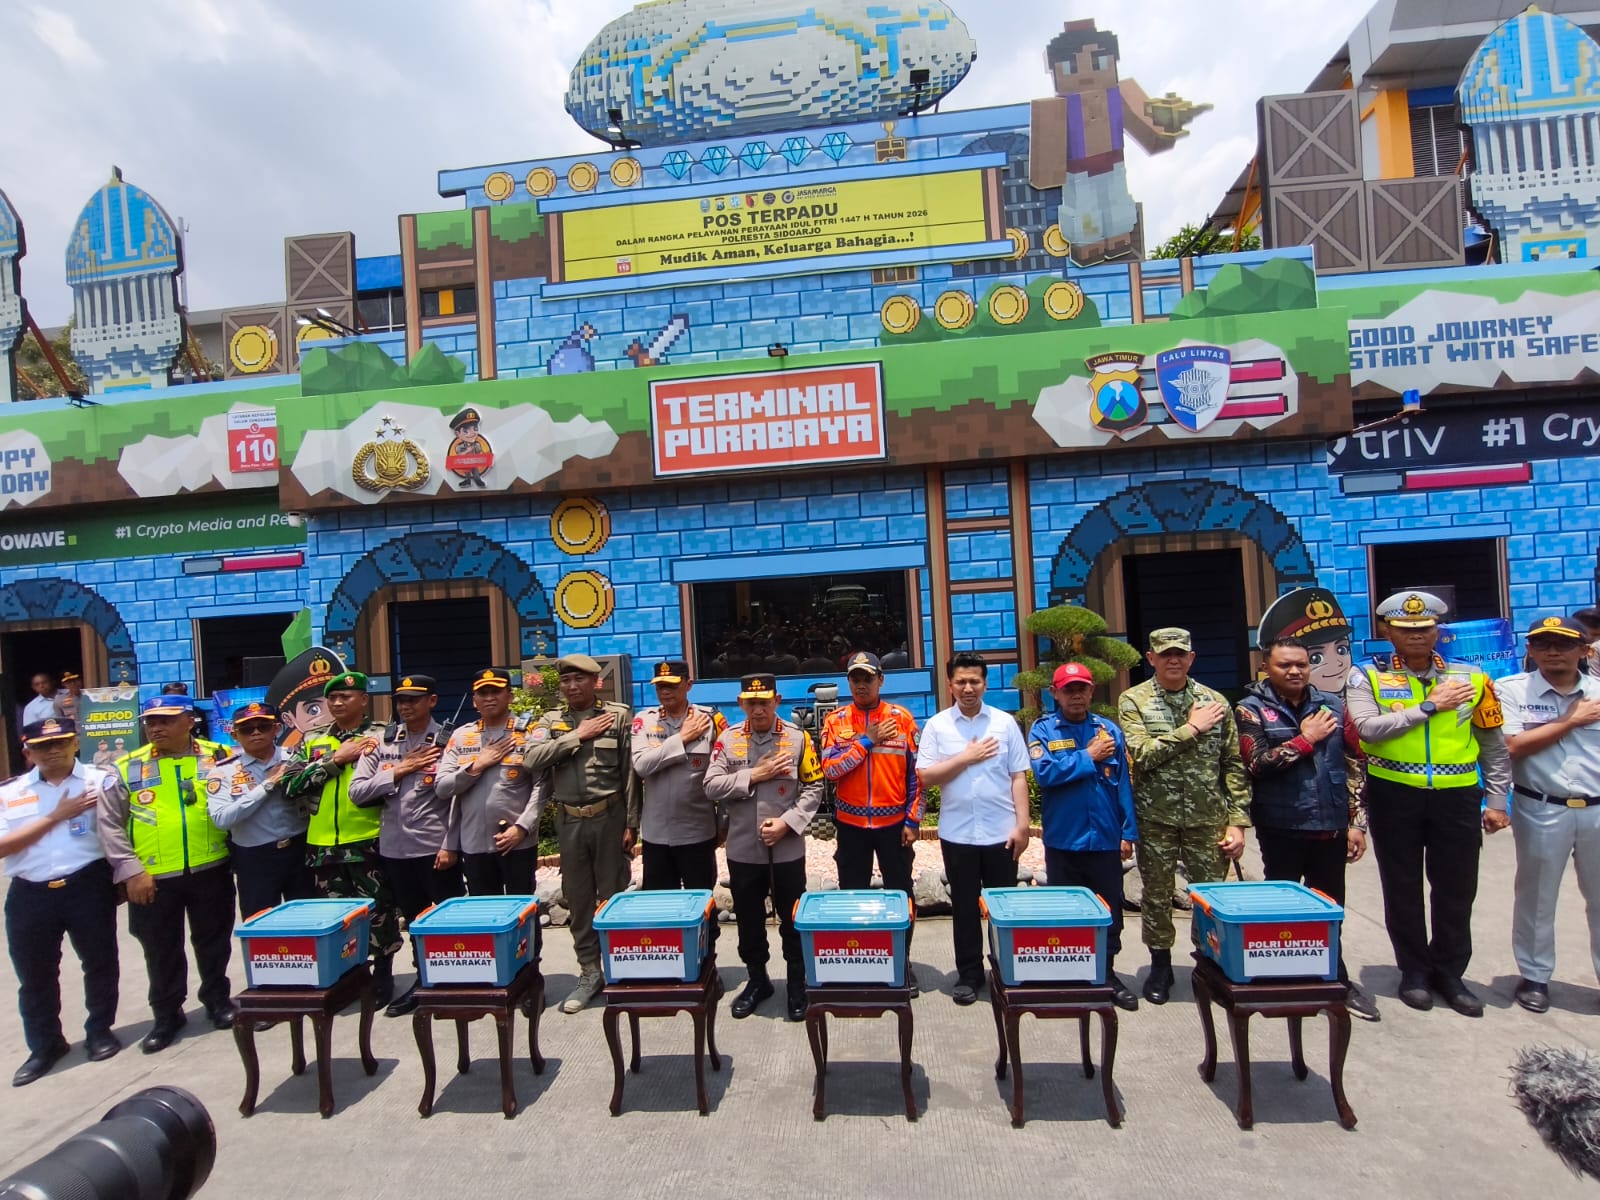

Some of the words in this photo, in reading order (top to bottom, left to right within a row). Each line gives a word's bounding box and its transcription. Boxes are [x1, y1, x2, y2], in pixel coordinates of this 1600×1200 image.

[703, 213, 741, 229] POS
[747, 202, 838, 225] TERPADU
[616, 237, 646, 246] DALAM
[648, 233, 685, 243] RANGKA
[688, 228, 739, 239] PELAYANAN
[741, 223, 788, 234] PERAYAAN
[790, 219, 811, 228] IDUL
[814, 218, 837, 226] FITRI
[840, 216, 861, 224] 1447
[873, 212, 904, 221] TAHUN
[907, 209, 928, 218] 2026
[722, 232, 770, 243] POLRESTA
[773, 227, 821, 239] SIDOARJO
[660, 251, 707, 265] Mudik
[712, 247, 760, 261] Aman,
[763, 240, 832, 255] Keluarga
[836, 231, 914, 248] Bahagia...!
[1348, 325, 1416, 348] GOOD
[1428, 315, 1553, 342] JOURNEY
[1163, 351, 1187, 363] LALU
[1190, 349, 1225, 359] LINTAS
[1349, 345, 1434, 369] START
[1446, 340, 1515, 362] WITH
[1526, 333, 1600, 357] SAFE
[1092, 355, 1114, 366] JAWA
[1115, 354, 1138, 363] TIMUR
[662, 382, 871, 425] TERMINAL
[664, 413, 873, 458] PURABAYA
[1352, 417, 1446, 460] triv
[1482, 417, 1527, 447] #1
[236, 438, 276, 463] 110
[0, 447, 36, 470] PY
[1, 470, 49, 494] DAY
[114, 526, 132, 539] #1
[136, 521, 184, 539] Crypto
[188, 515, 232, 532] Media
[236, 513, 266, 529] and
[0, 530, 66, 551] OWAVE
[1519, 703, 1558, 713] NORIES
[86, 710, 133, 723] JEKPOD
[613, 946, 643, 954] POLRI
[645, 945, 680, 953] UNTUK
[1017, 946, 1050, 954] POLRI
[1052, 946, 1091, 954] UNTUK
[1248, 940, 1284, 949] POLRI
[1286, 939, 1324, 948] UNTUK
[253, 953, 280, 962] POLRI
[282, 954, 314, 962] UNTUK
[428, 951, 457, 959] POLRI
[459, 950, 492, 959] UNTUK
[613, 953, 680, 962] MASYARAKAT
[818, 948, 849, 956] POLRI
[852, 948, 889, 956] UNTUK
[1248, 948, 1325, 958] MASYARAKAT
[254, 961, 314, 969] MASYARAKAT
[429, 959, 492, 967] MASYARAKAT
[819, 956, 890, 965] MASYARAKAT
[1017, 955, 1092, 963] MASYARAKAT
